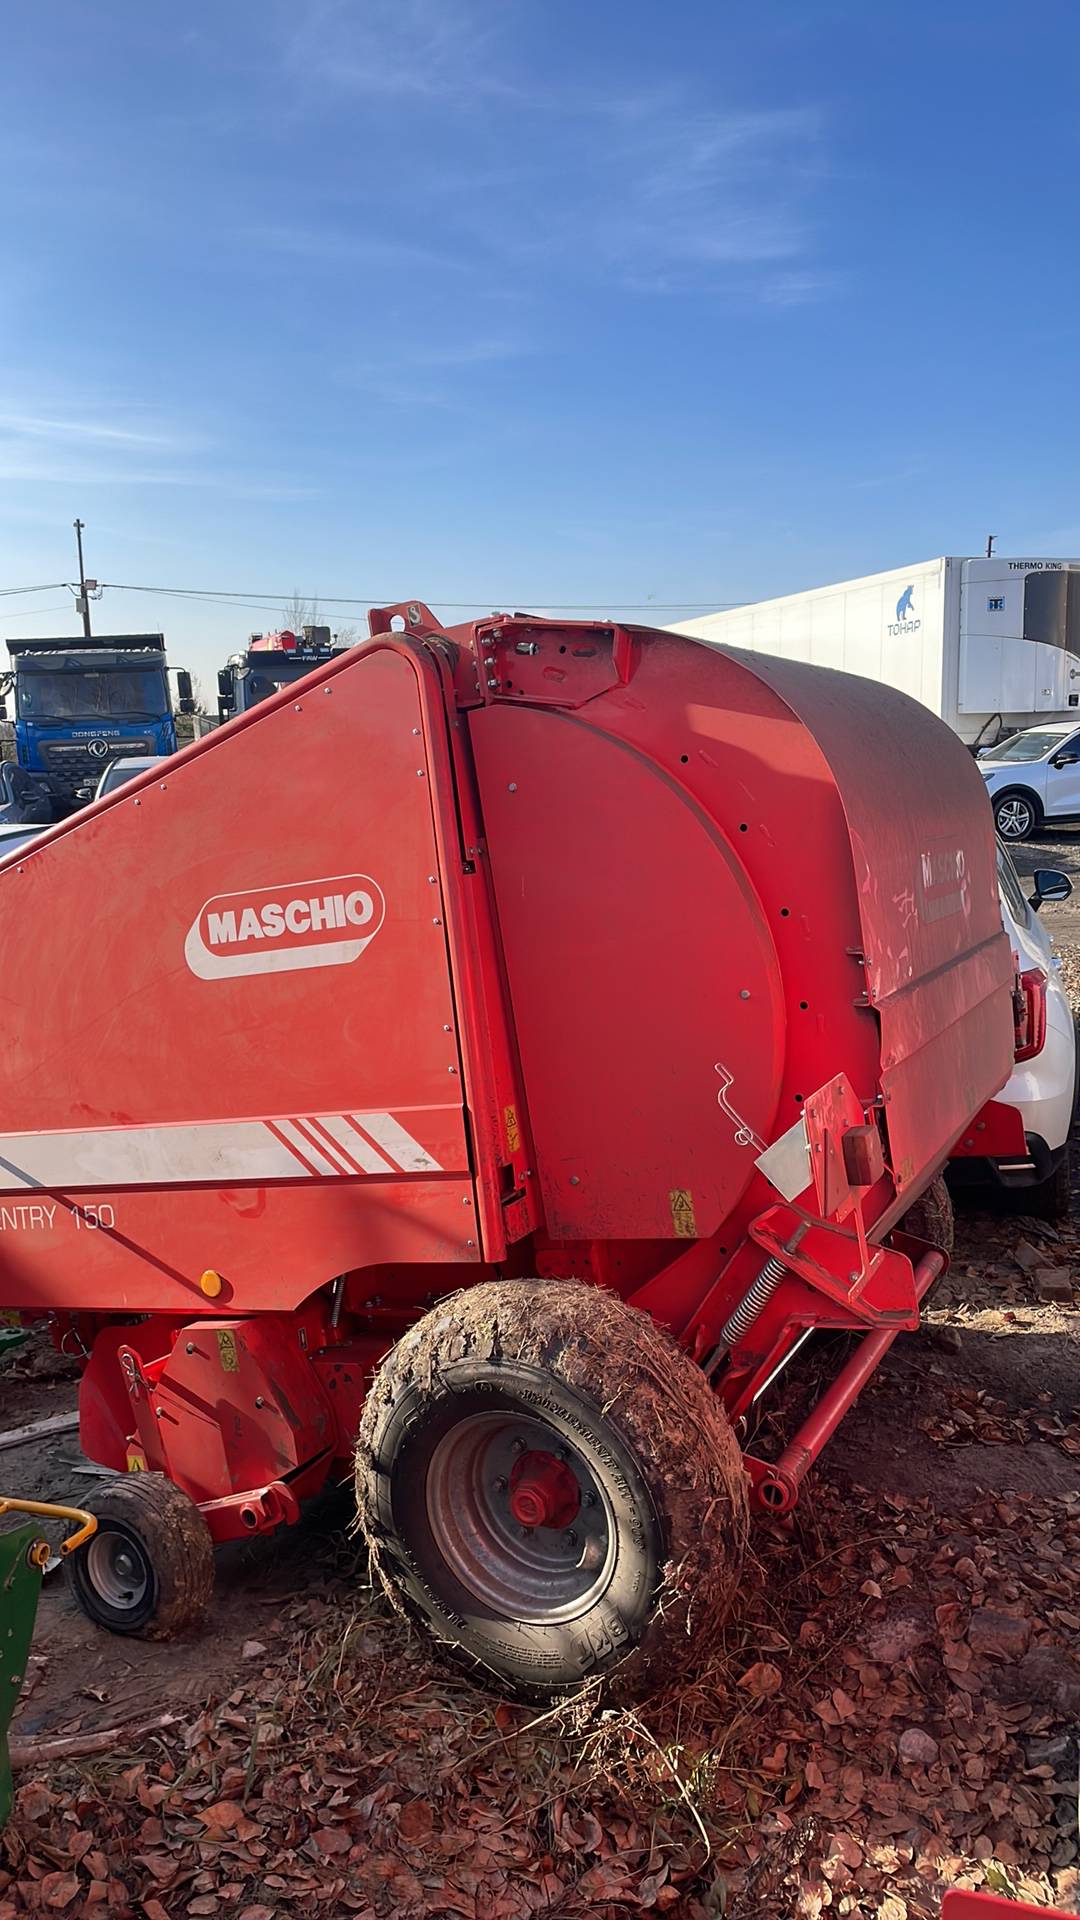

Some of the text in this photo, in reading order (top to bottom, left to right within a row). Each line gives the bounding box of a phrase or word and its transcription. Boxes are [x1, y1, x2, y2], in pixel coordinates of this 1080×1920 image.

[1008, 562, 1063, 570] THERMO KING
[888, 619, 921, 636] ТОНАР
[72, 730, 120, 738] DONGFENG
[207, 890, 374, 945] MASCHIO
[0, 1204, 115, 1230] NTRY 150
